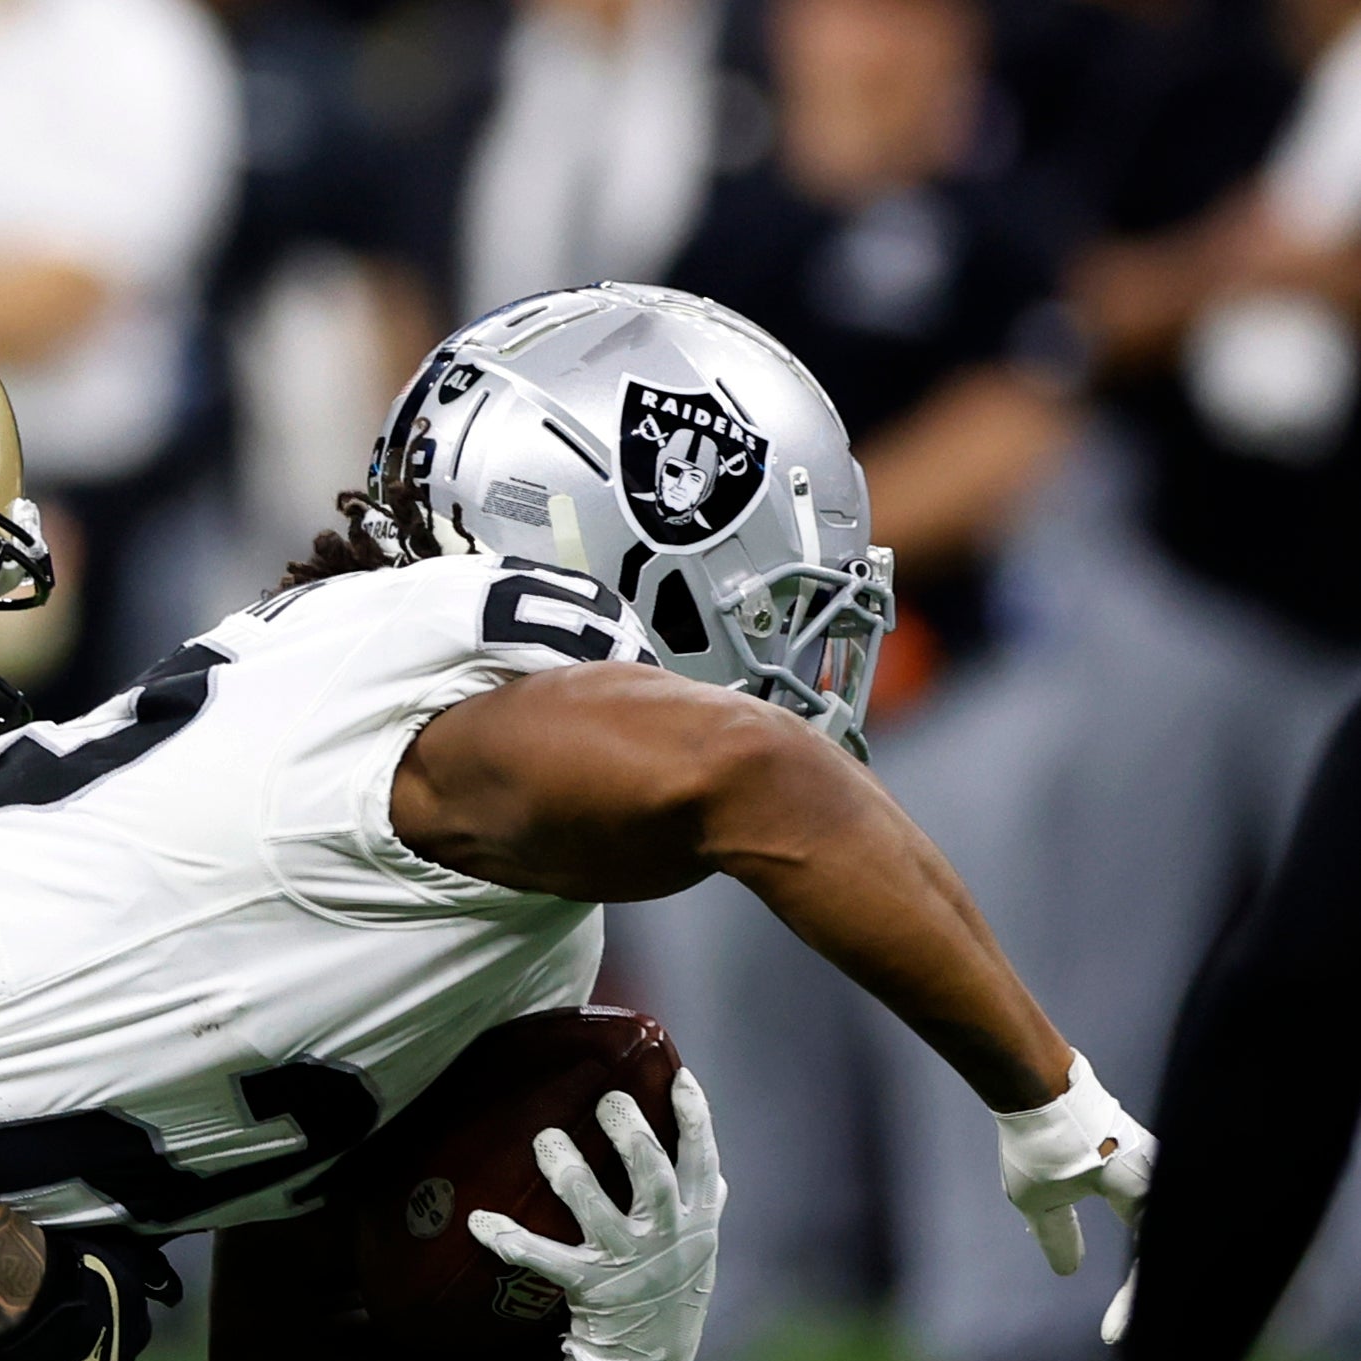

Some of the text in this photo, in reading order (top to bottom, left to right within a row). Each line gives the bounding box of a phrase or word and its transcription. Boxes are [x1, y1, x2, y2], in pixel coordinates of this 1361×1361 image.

[443, 369, 473, 391] AL
[640, 390, 757, 451] RAIDERS
[373, 520, 399, 540] RAC
[481, 555, 662, 666] 2
